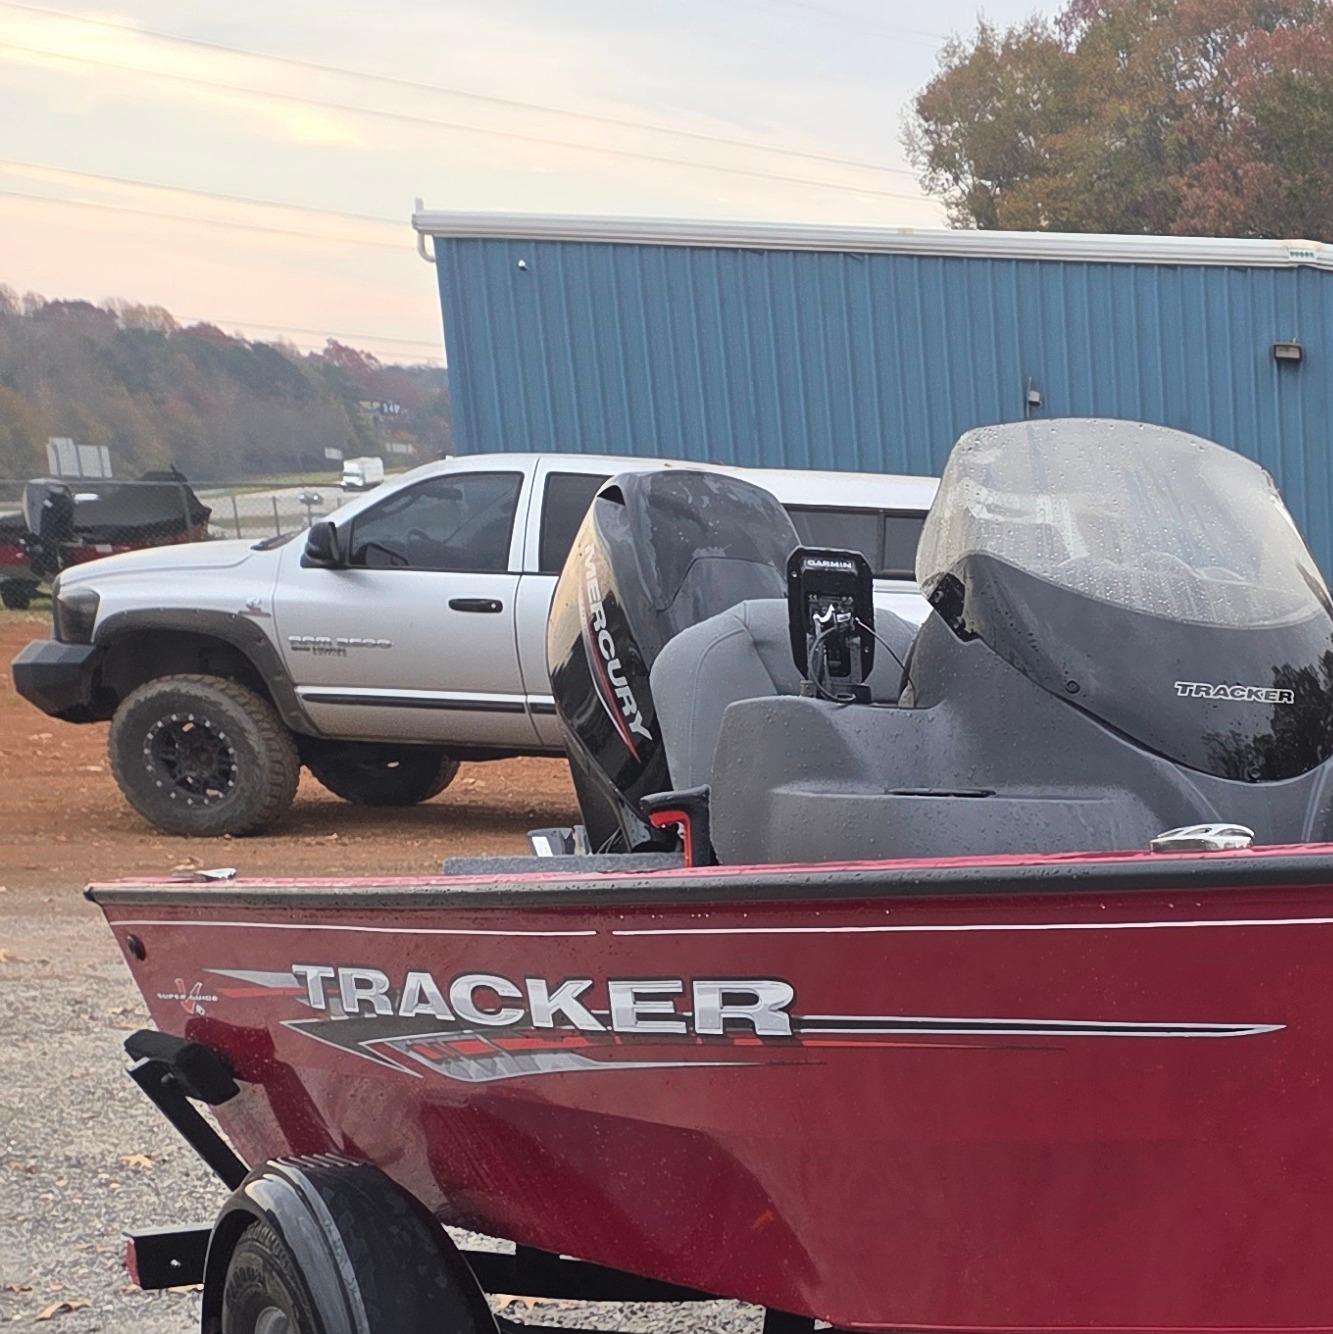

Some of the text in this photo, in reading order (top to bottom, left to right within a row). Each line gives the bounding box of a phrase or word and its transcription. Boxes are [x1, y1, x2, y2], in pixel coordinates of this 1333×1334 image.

[807, 559, 852, 569] GARMIN
[584, 543, 653, 740] MERCURY
[1174, 681, 1295, 704] TRACKER
[292, 964, 795, 1036] TRACKER
